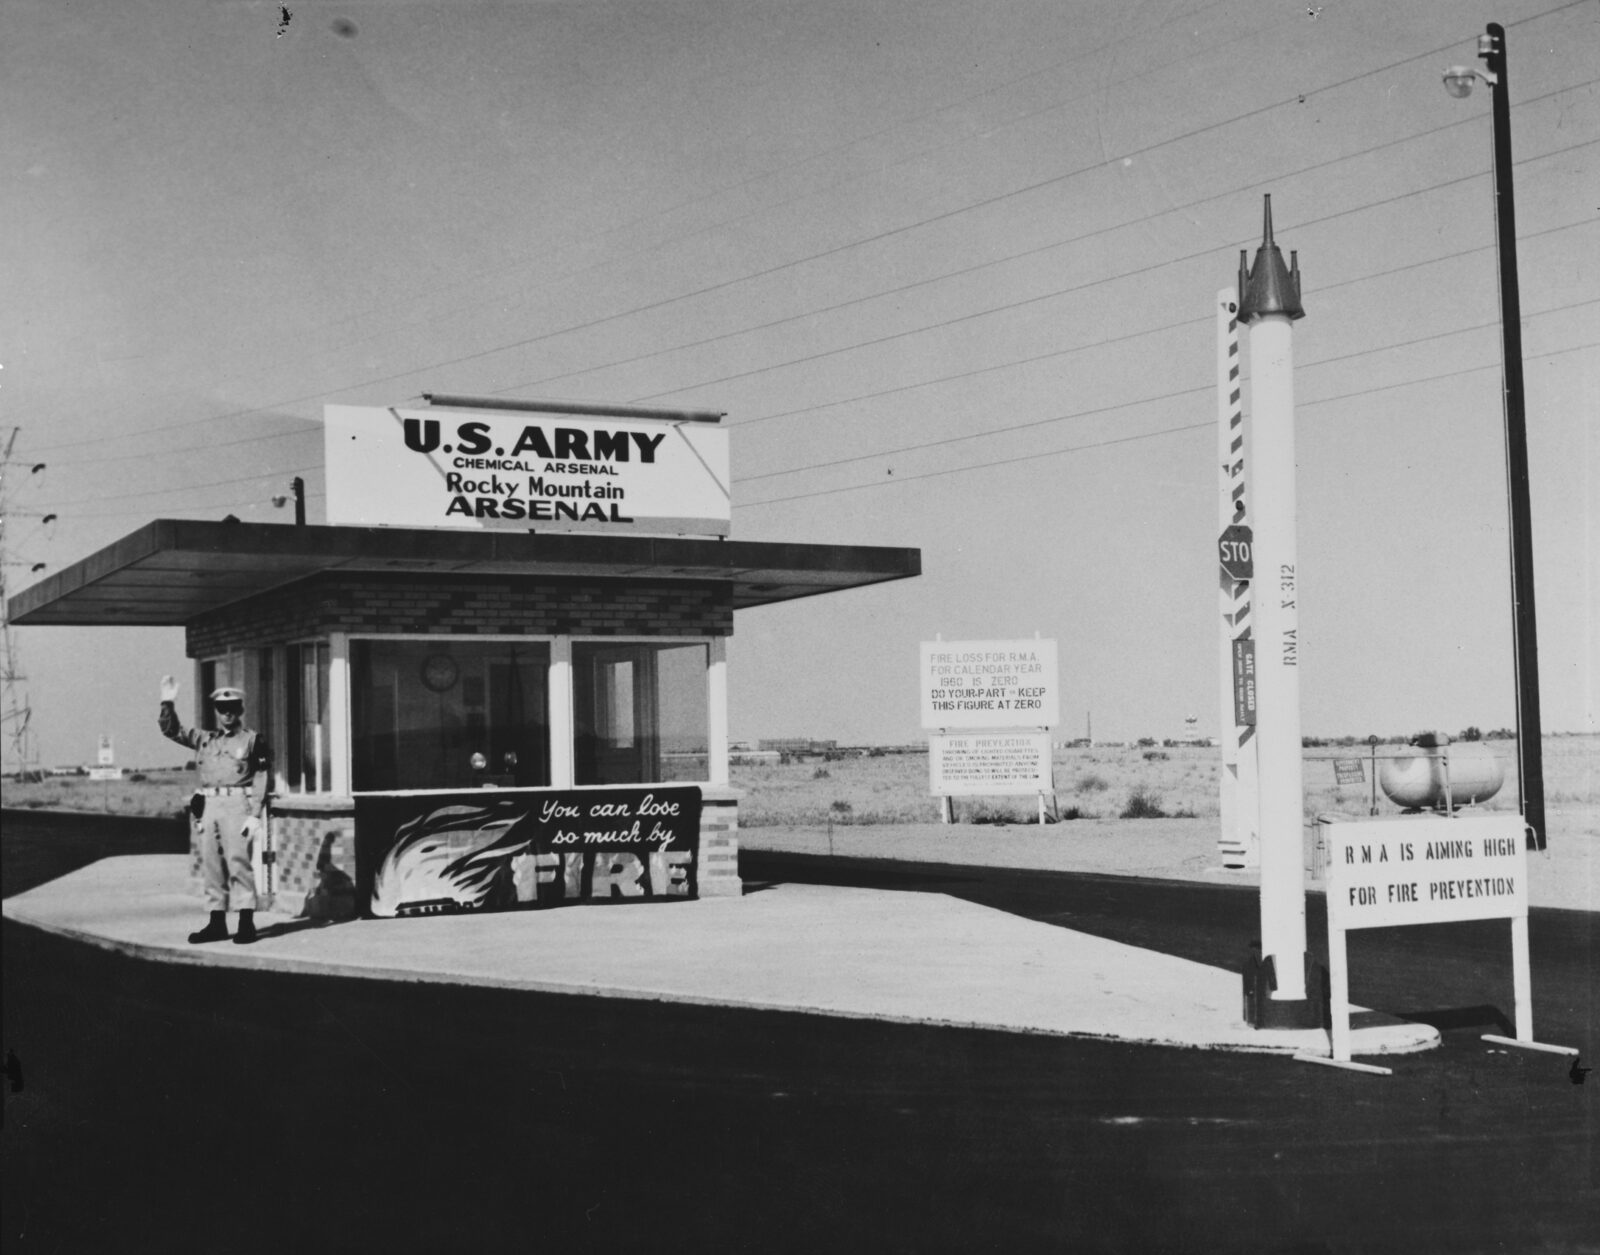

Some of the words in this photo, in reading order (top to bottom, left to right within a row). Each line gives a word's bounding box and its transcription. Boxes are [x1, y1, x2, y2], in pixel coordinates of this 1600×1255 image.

[404, 419, 505, 456] U.S.
[511, 426, 666, 463] ARMY
[453, 457, 535, 472] CHEMICAL
[544, 463, 619, 475] ARSENAL
[446, 472, 519, 497] Rocky
[529, 476, 624, 499] Mountain
[446, 496, 634, 523] ARSENAL
[1220, 541, 1252, 562] STO
[930, 654, 953, 663] FIRE
[956, 653, 983, 663] LOSS
[985, 652, 1005, 662] FOR
[1283, 629, 1297, 666] RMA
[931, 665, 951, 675] FOR
[954, 665, 1010, 674] CALENDAR
[1014, 664, 1042, 673] YEAR
[940, 677, 963, 687] 1960
[972, 677, 982, 686] IS
[991, 676, 1018, 686] ZERO
[932, 689, 945, 699] DO
[1018, 687, 1046, 697] KEEP
[932, 701, 955, 710] THIS
[957, 700, 994, 710] FIGURE
[997, 700, 1011, 709] AT
[1014, 700, 1041, 709] ZERO
[1247, 680, 1255, 711] CLOSED
[949, 740, 968, 748] FIRE
[976, 739, 1032, 747] PREVENTION
[538, 800, 580, 823] You
[590, 804, 631, 816] can
[635, 794, 680, 816] lose
[552, 830, 579, 843] so
[584, 820, 641, 843] much
[645, 821, 676, 852] by
[1400, 843, 1414, 861] IS
[1426, 840, 1473, 860] AIMING
[1483, 838, 1516, 857] HIGH
[511, 850, 692, 902] FIRE
[1349, 886, 1377, 906] FOR
[1388, 883, 1419, 903] FIRE
[1430, 877, 1515, 900] PREVENTION
